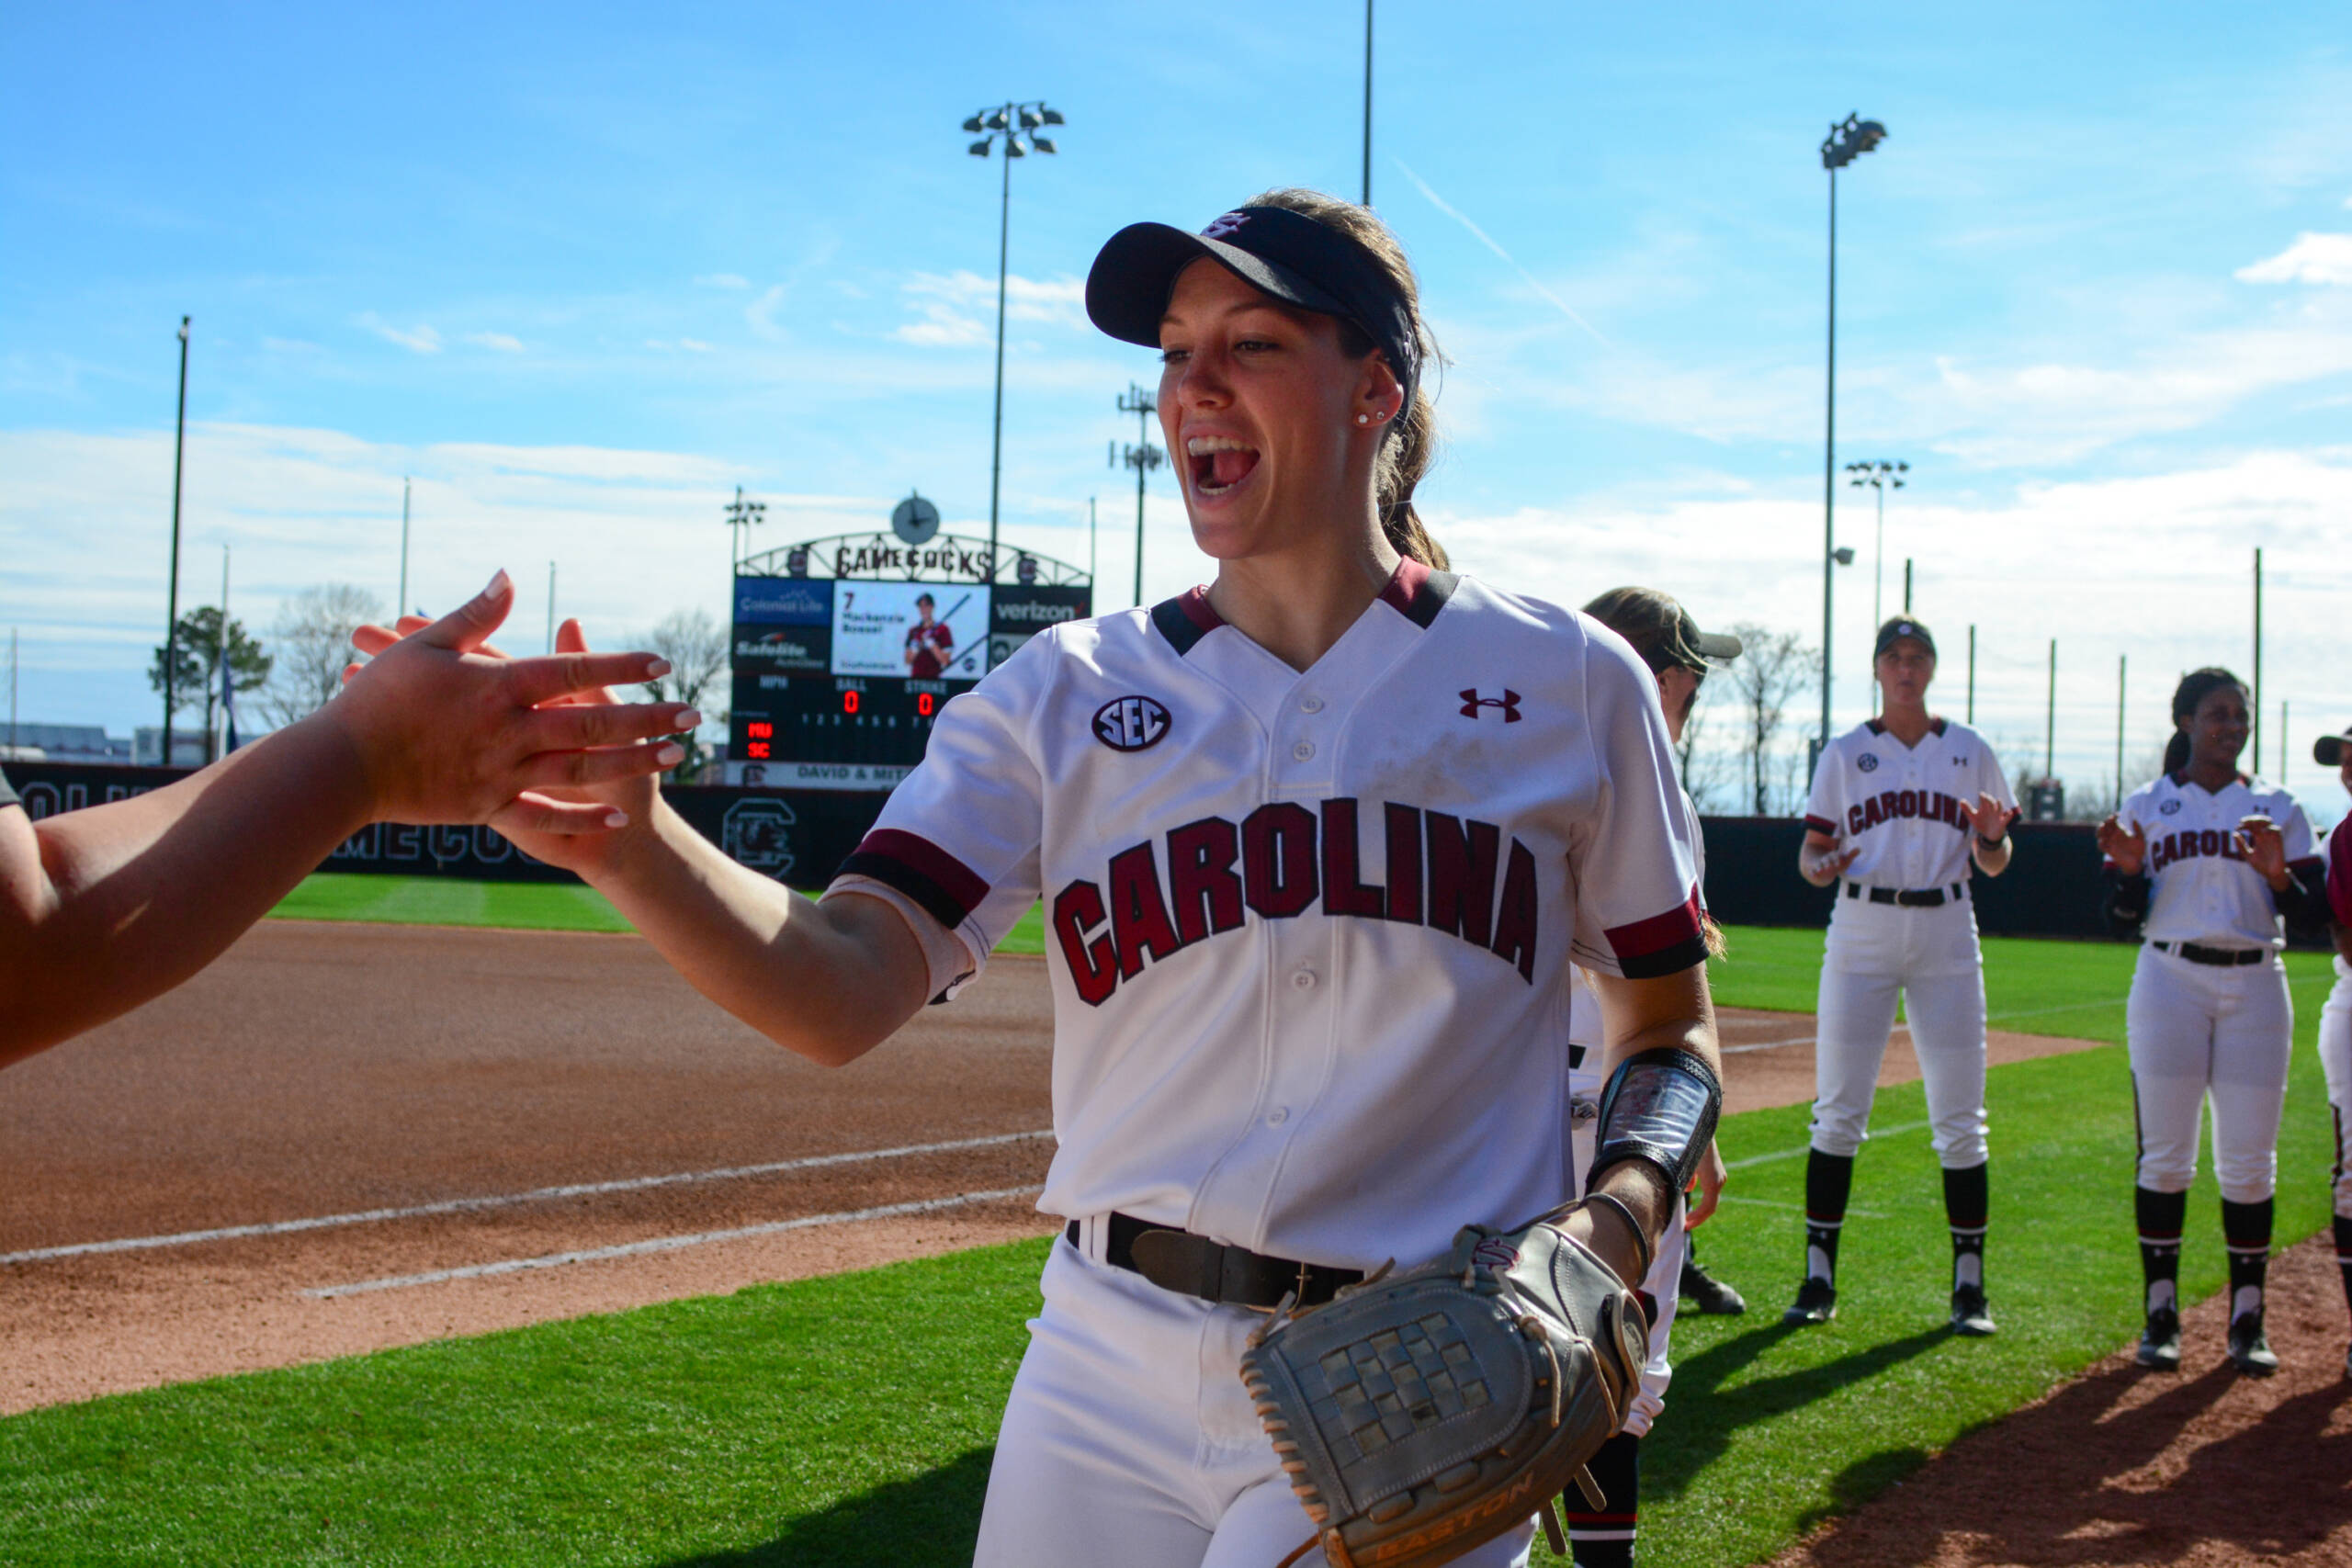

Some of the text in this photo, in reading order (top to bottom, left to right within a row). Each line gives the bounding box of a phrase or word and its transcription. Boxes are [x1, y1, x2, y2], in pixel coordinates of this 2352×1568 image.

[835, 545, 992, 583] GAMECOCKS
[842, 592, 855, 611] 7
[996, 600, 1076, 622] verizon
[759, 675, 789, 689] MPH
[836, 677, 866, 694] BALL
[904, 680, 947, 695] STRIKE
[843, 690, 859, 714] 0
[919, 693, 933, 716] 0
[801, 714, 808, 726] 1
[816, 714, 824, 727] 2
[833, 714, 841, 727] 3
[1099, 698, 1164, 747] SEC
[748, 741, 771, 759] SC
[797, 765, 911, 782] DAVID & MIT
[1054, 797, 1538, 1007] CAROLINA
